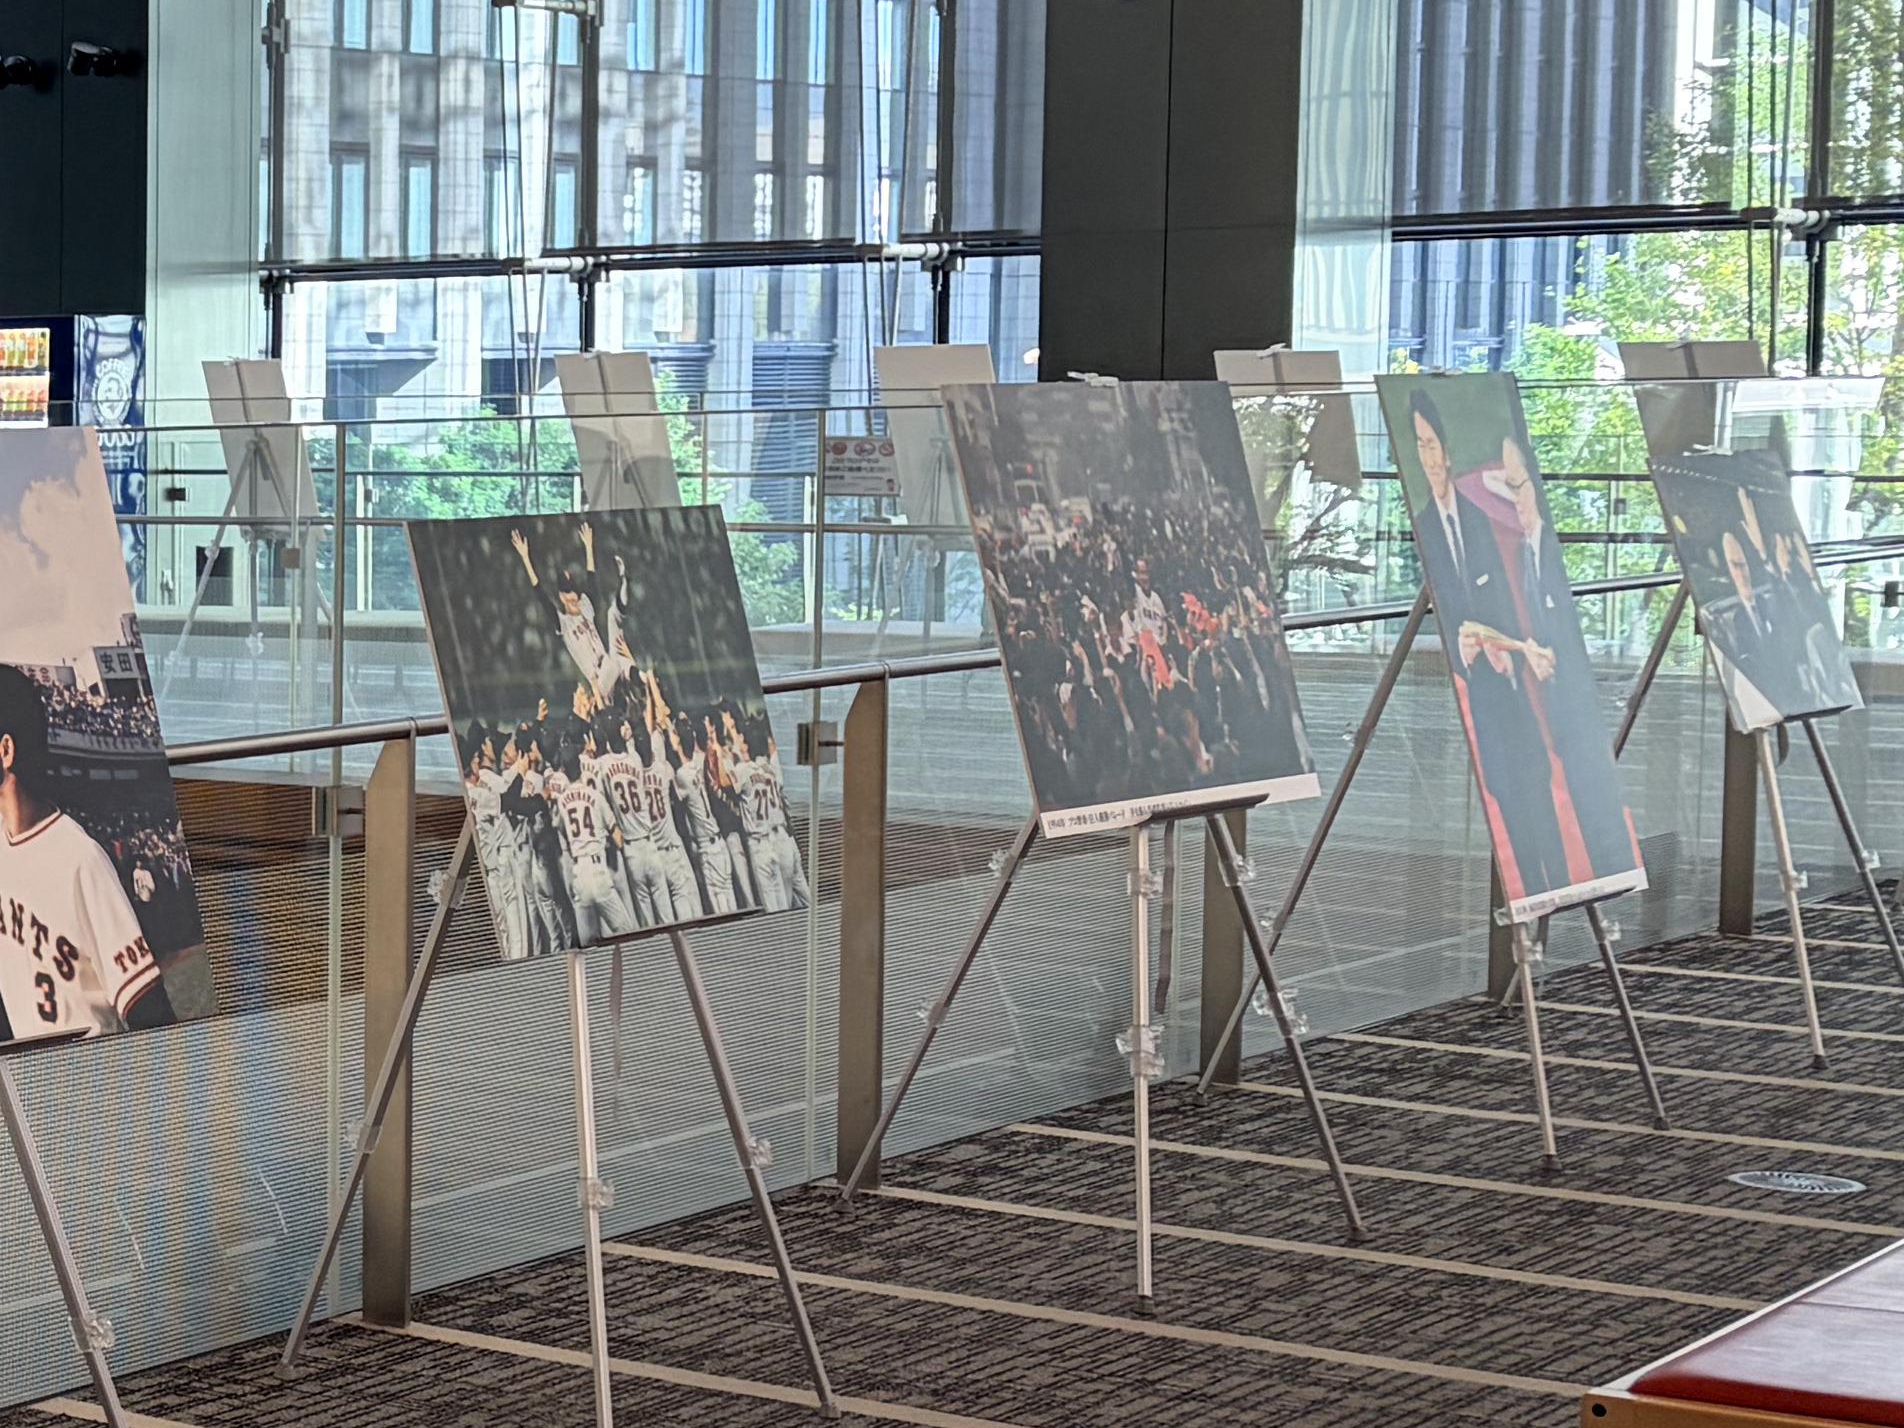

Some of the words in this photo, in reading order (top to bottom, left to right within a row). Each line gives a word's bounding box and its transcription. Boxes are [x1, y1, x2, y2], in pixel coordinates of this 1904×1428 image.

[614, 780, 642, 815] 36
[567, 806, 596, 838] 54
[35, 972, 58, 1024] 3
